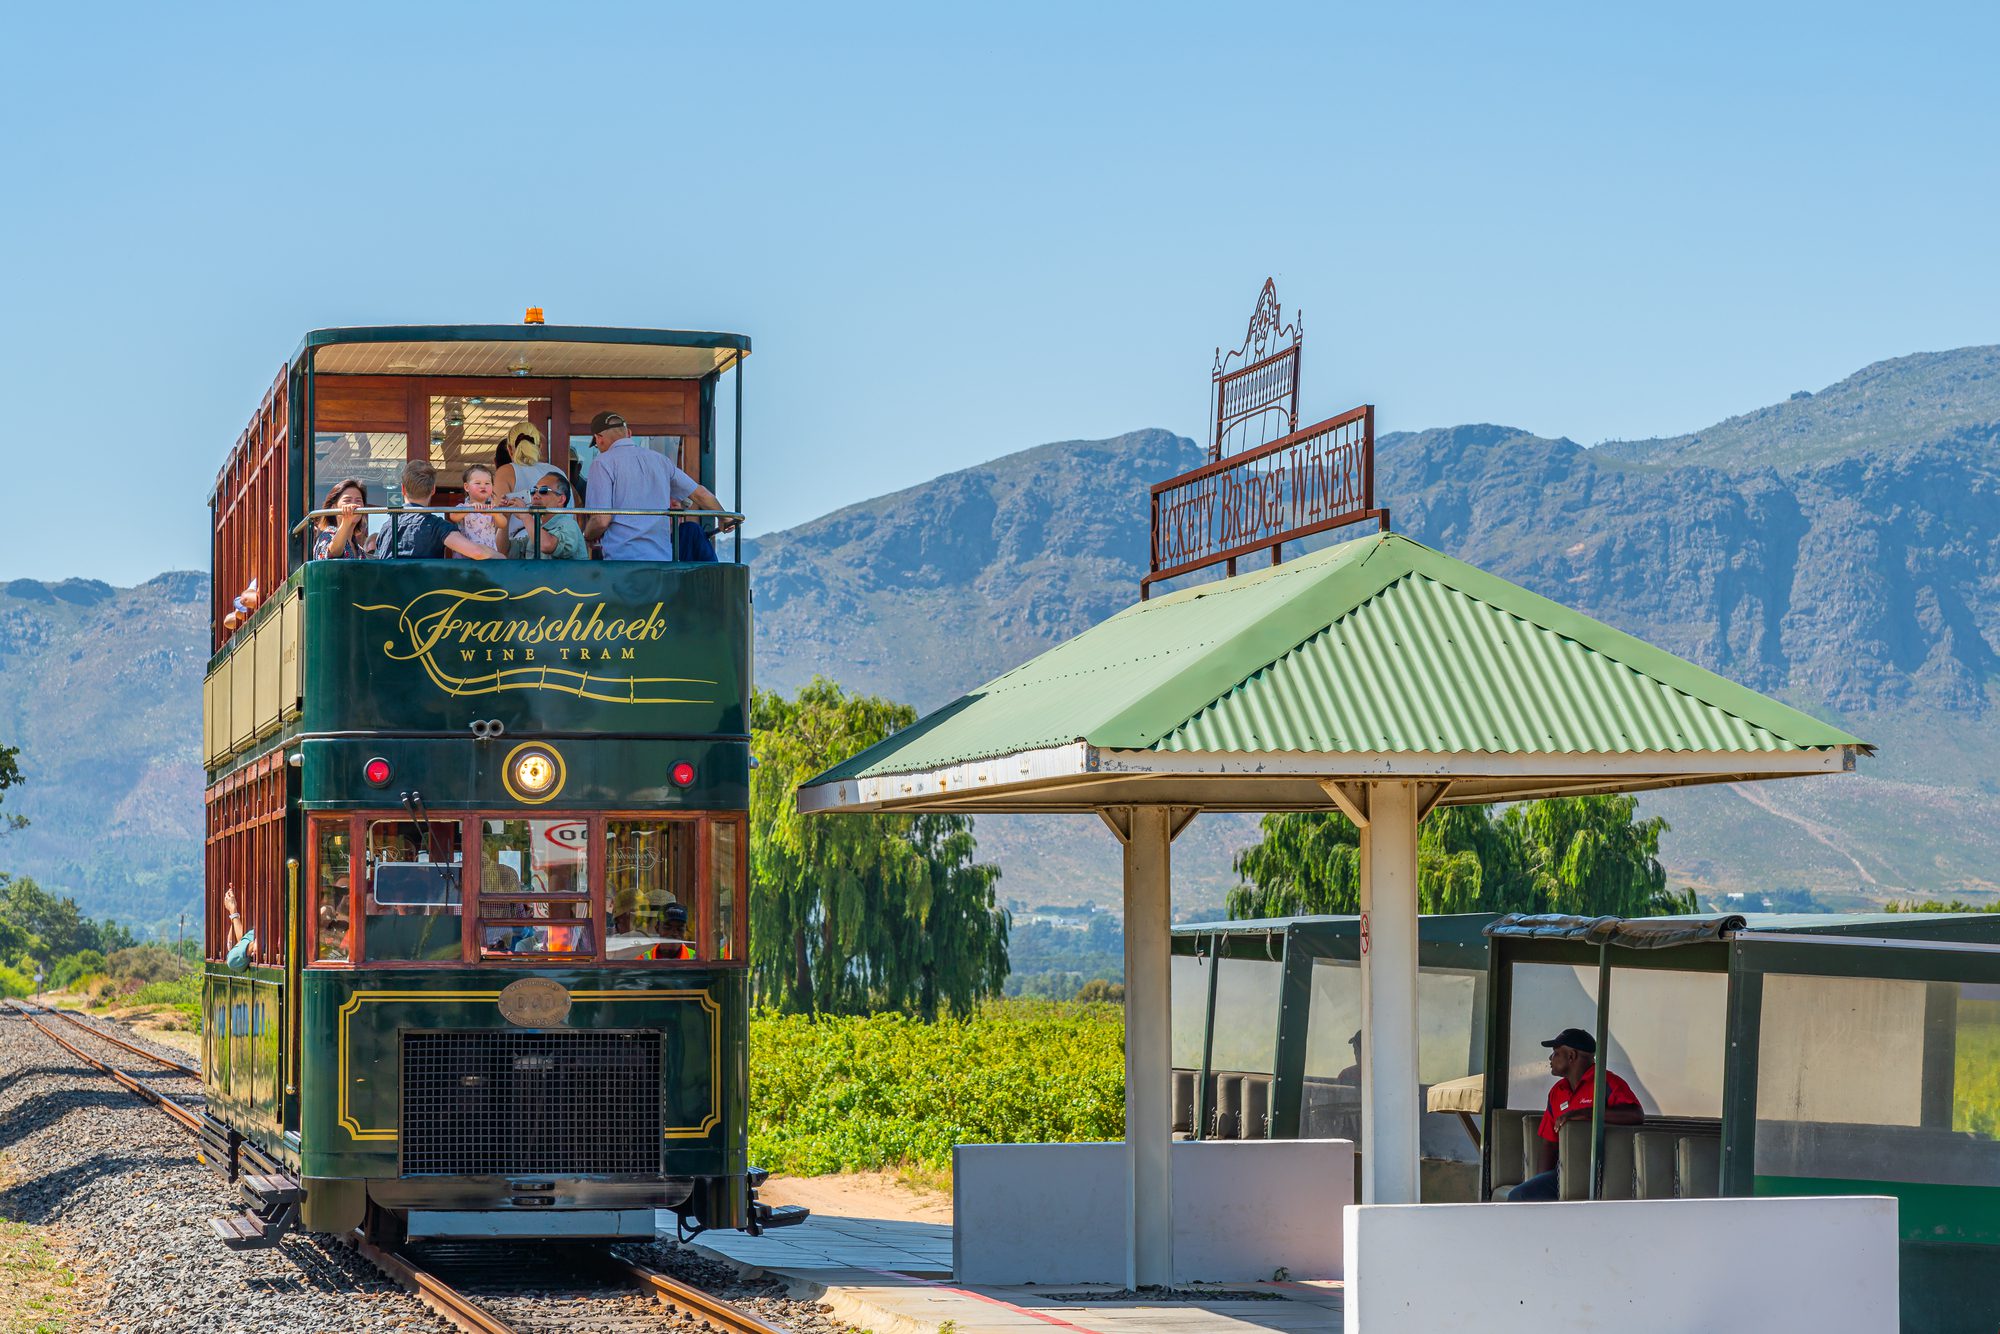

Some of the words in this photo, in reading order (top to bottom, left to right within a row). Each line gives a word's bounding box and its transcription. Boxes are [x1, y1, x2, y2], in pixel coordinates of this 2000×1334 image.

[1150, 490, 1217, 565] RICKETY
[1219, 466, 1286, 544] BRIDGE
[1289, 436, 1367, 528] WINERY
[384, 589, 667, 661] Franschhoek
[460, 649, 535, 662] WINE
[560, 648, 635, 661] TRAM
